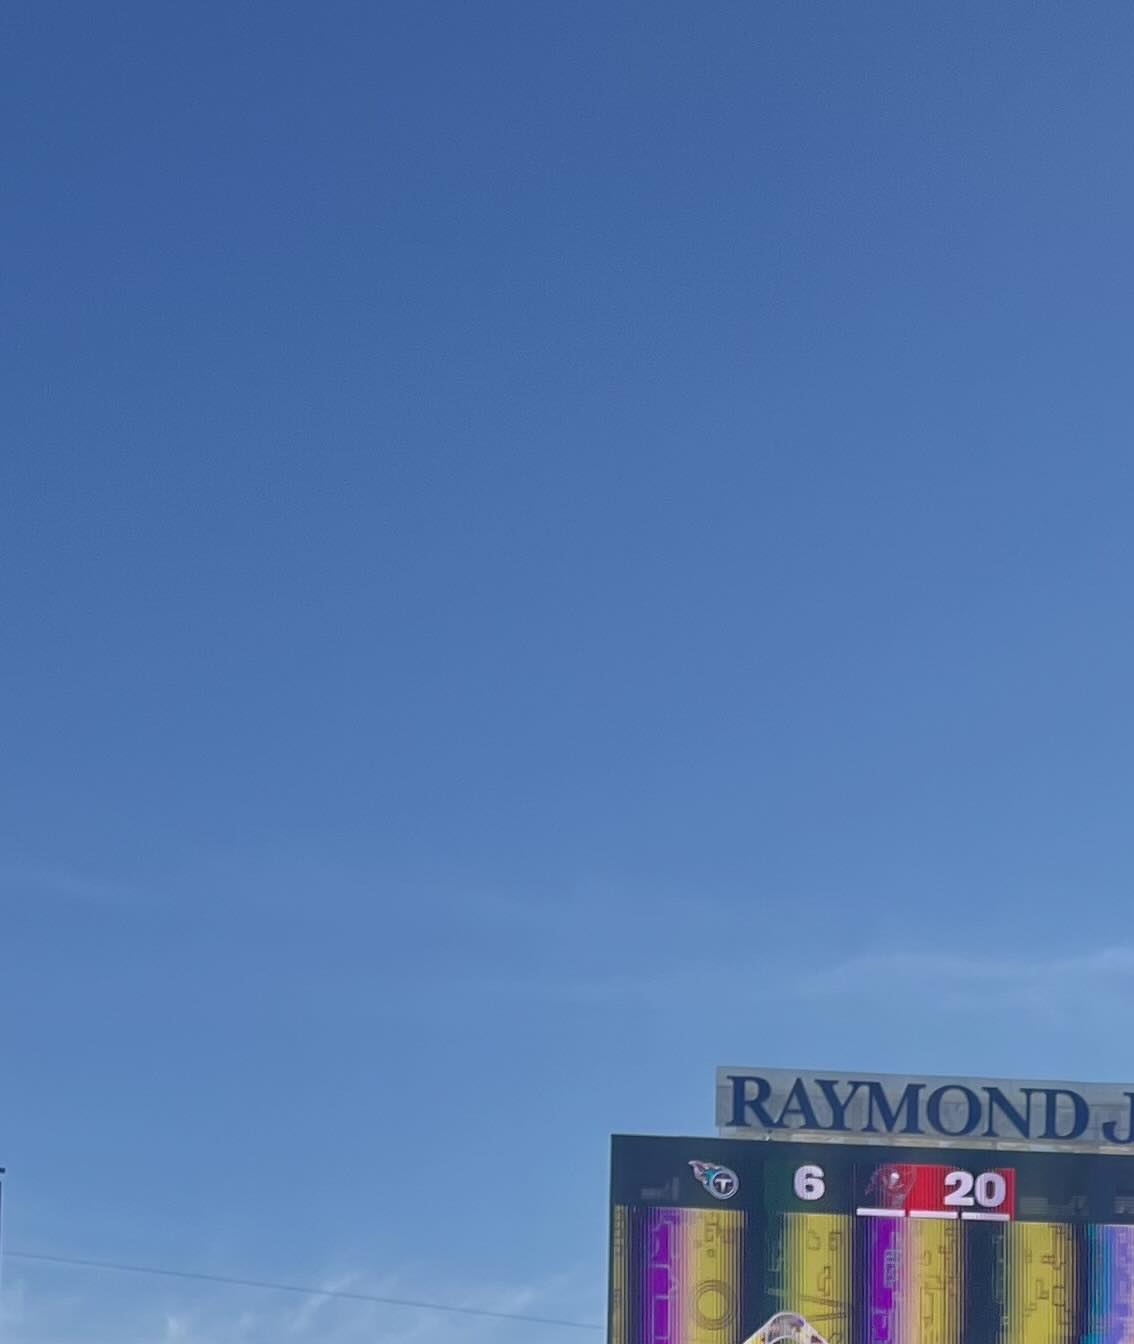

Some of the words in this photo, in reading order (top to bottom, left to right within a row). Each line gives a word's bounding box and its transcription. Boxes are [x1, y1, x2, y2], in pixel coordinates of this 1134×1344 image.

[727, 1075, 1090, 1140] RAYMOND
[794, 1165, 825, 1200] 6
[944, 1171, 1006, 1208] 20
